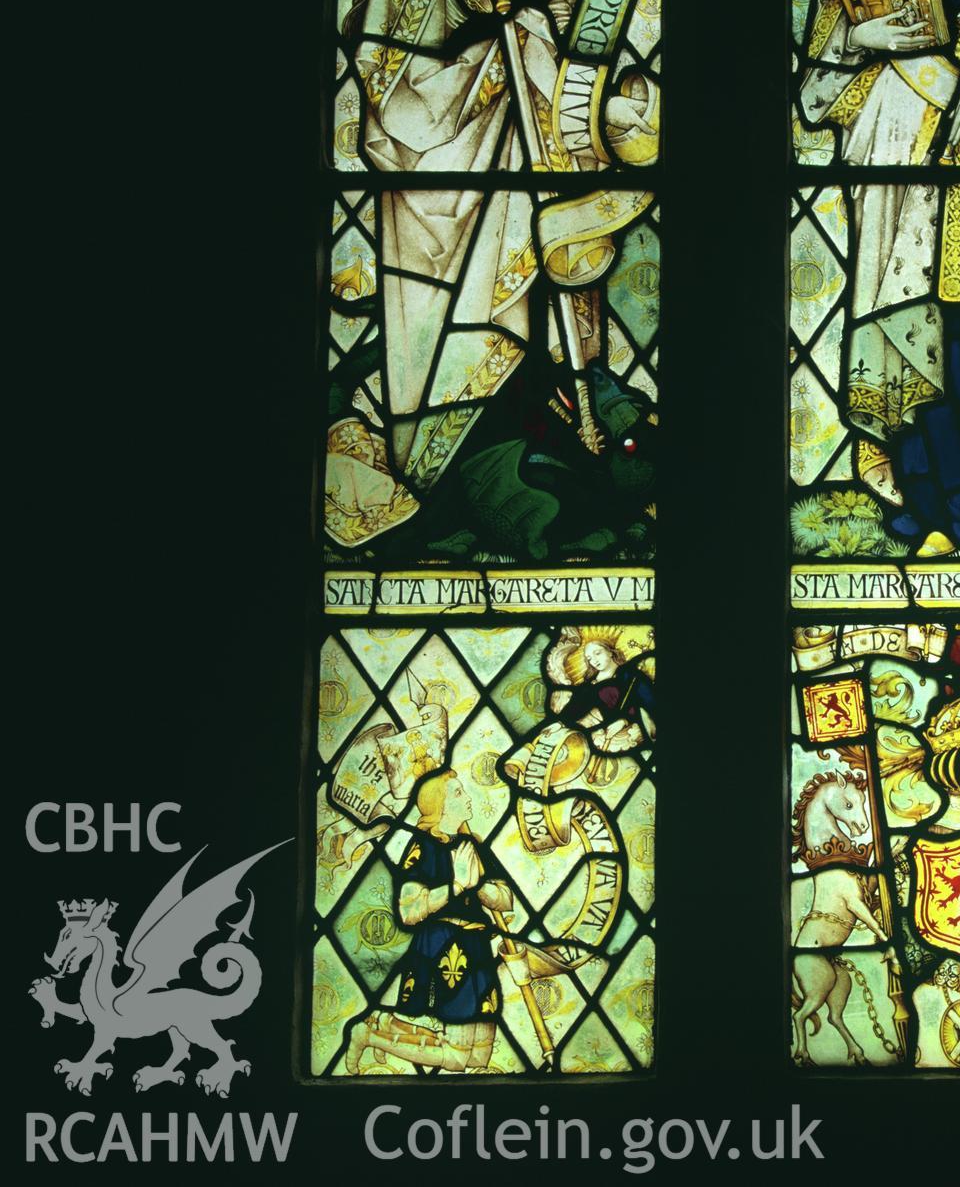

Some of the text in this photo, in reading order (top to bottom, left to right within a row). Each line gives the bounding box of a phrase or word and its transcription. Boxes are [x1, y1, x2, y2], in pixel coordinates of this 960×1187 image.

[325, 576, 653, 605] SANCTA MARGARETA V M
[792, 573, 840, 599] STA
[869, 630, 902, 652] DE
[335, 784, 371, 816] maria
[582, 897, 613, 932] VA
